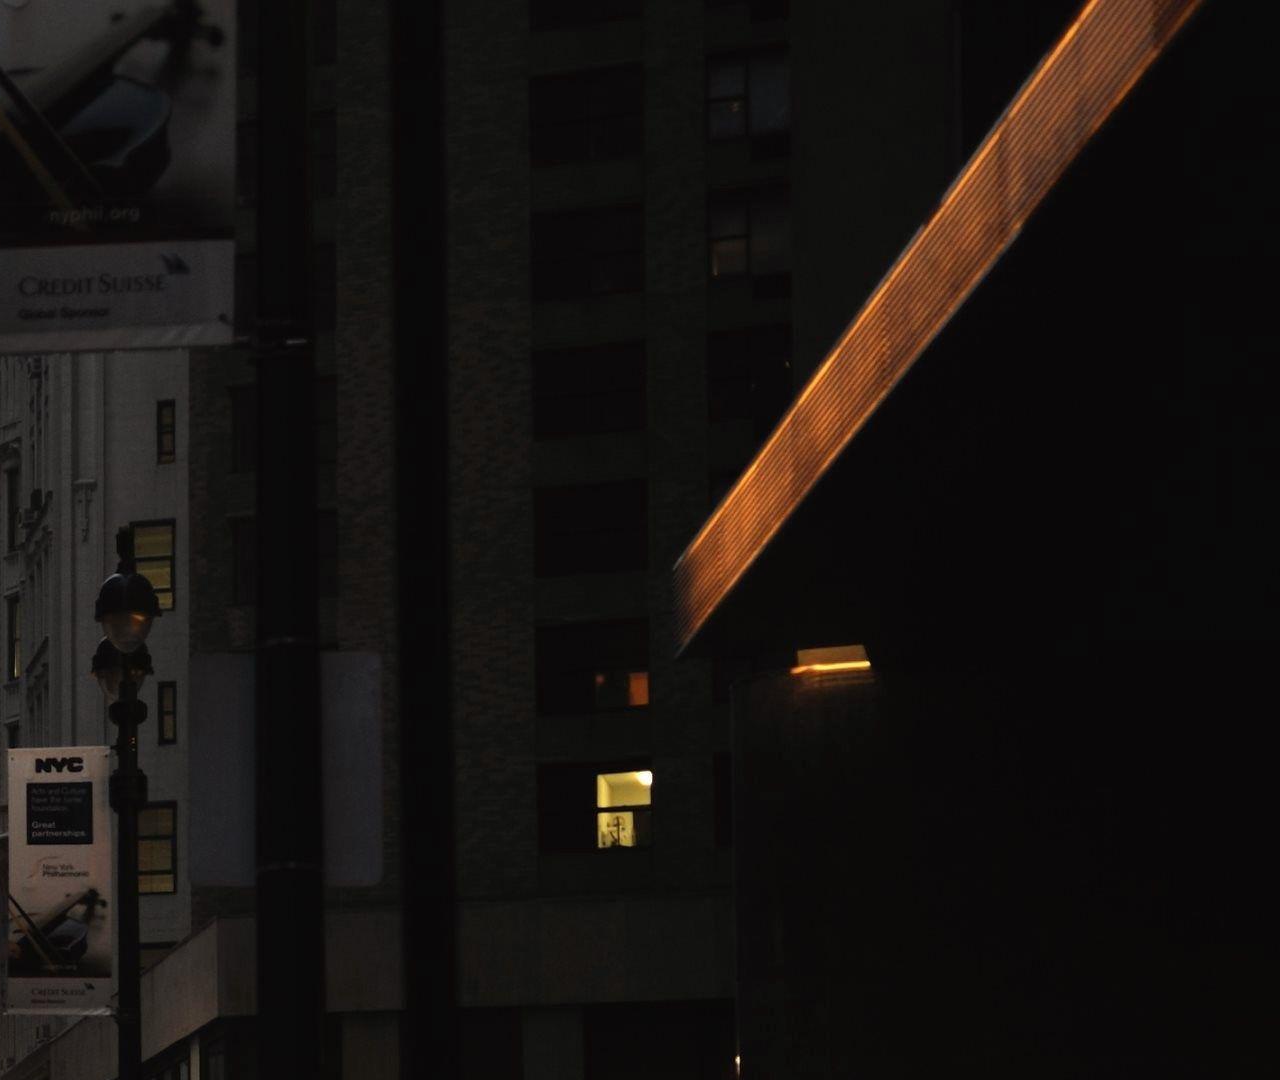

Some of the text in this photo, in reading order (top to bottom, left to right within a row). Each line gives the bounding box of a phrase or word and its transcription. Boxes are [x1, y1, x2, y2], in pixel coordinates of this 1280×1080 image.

[48, 205, 141, 225] nyphil.org
[18, 273, 168, 297] CREDIT SUISSE
[35, 757, 84, 774] NYC
[31, 821, 56, 829] Great
